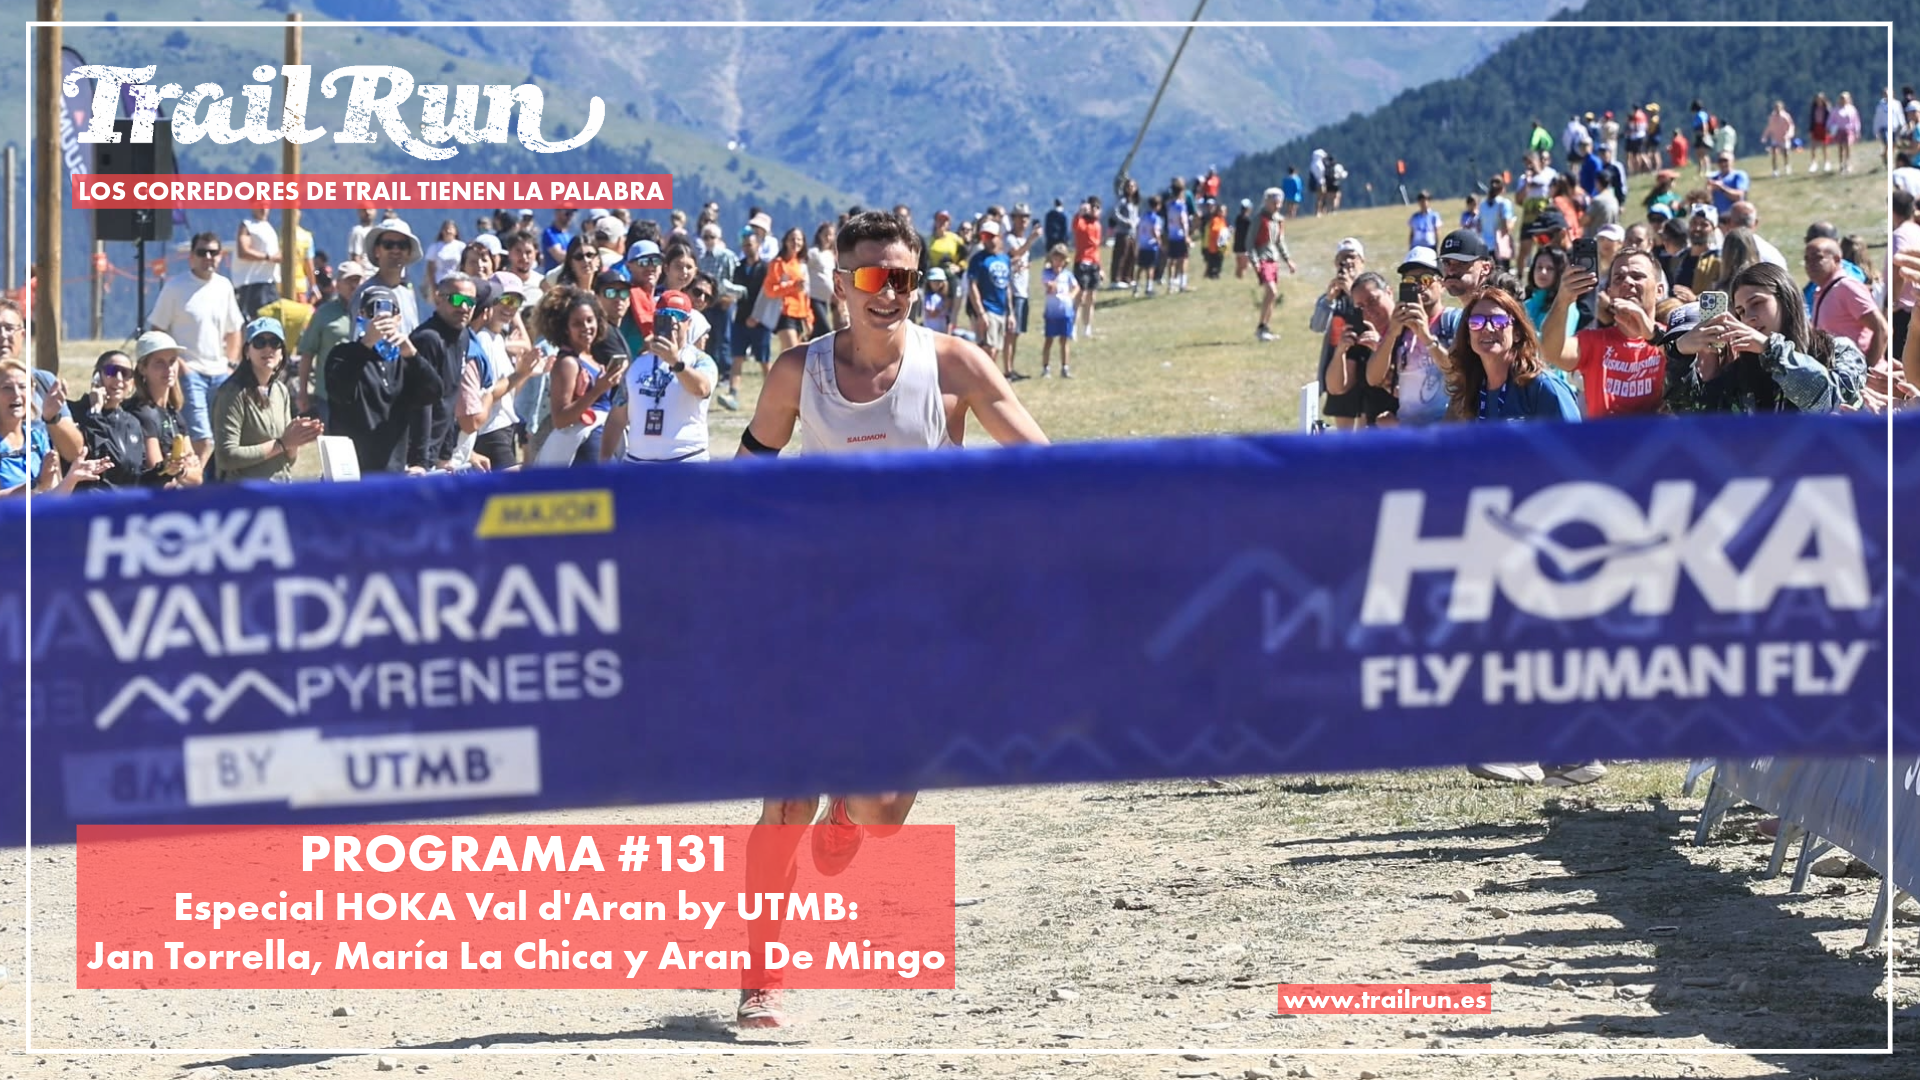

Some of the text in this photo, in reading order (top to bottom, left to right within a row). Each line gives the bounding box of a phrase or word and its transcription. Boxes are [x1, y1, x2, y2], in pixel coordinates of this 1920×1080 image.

[846, 432, 887, 444] SALOMON
[85, 507, 295, 580] HOKA
[501, 499, 599, 523] MAJOR
[1361, 476, 1870, 627] HOKA
[297, 650, 623, 716] PYRENEES
[1363, 642, 1868, 707] FLY HUMAN FLY
[214, 745, 494, 791] BY UTMB
